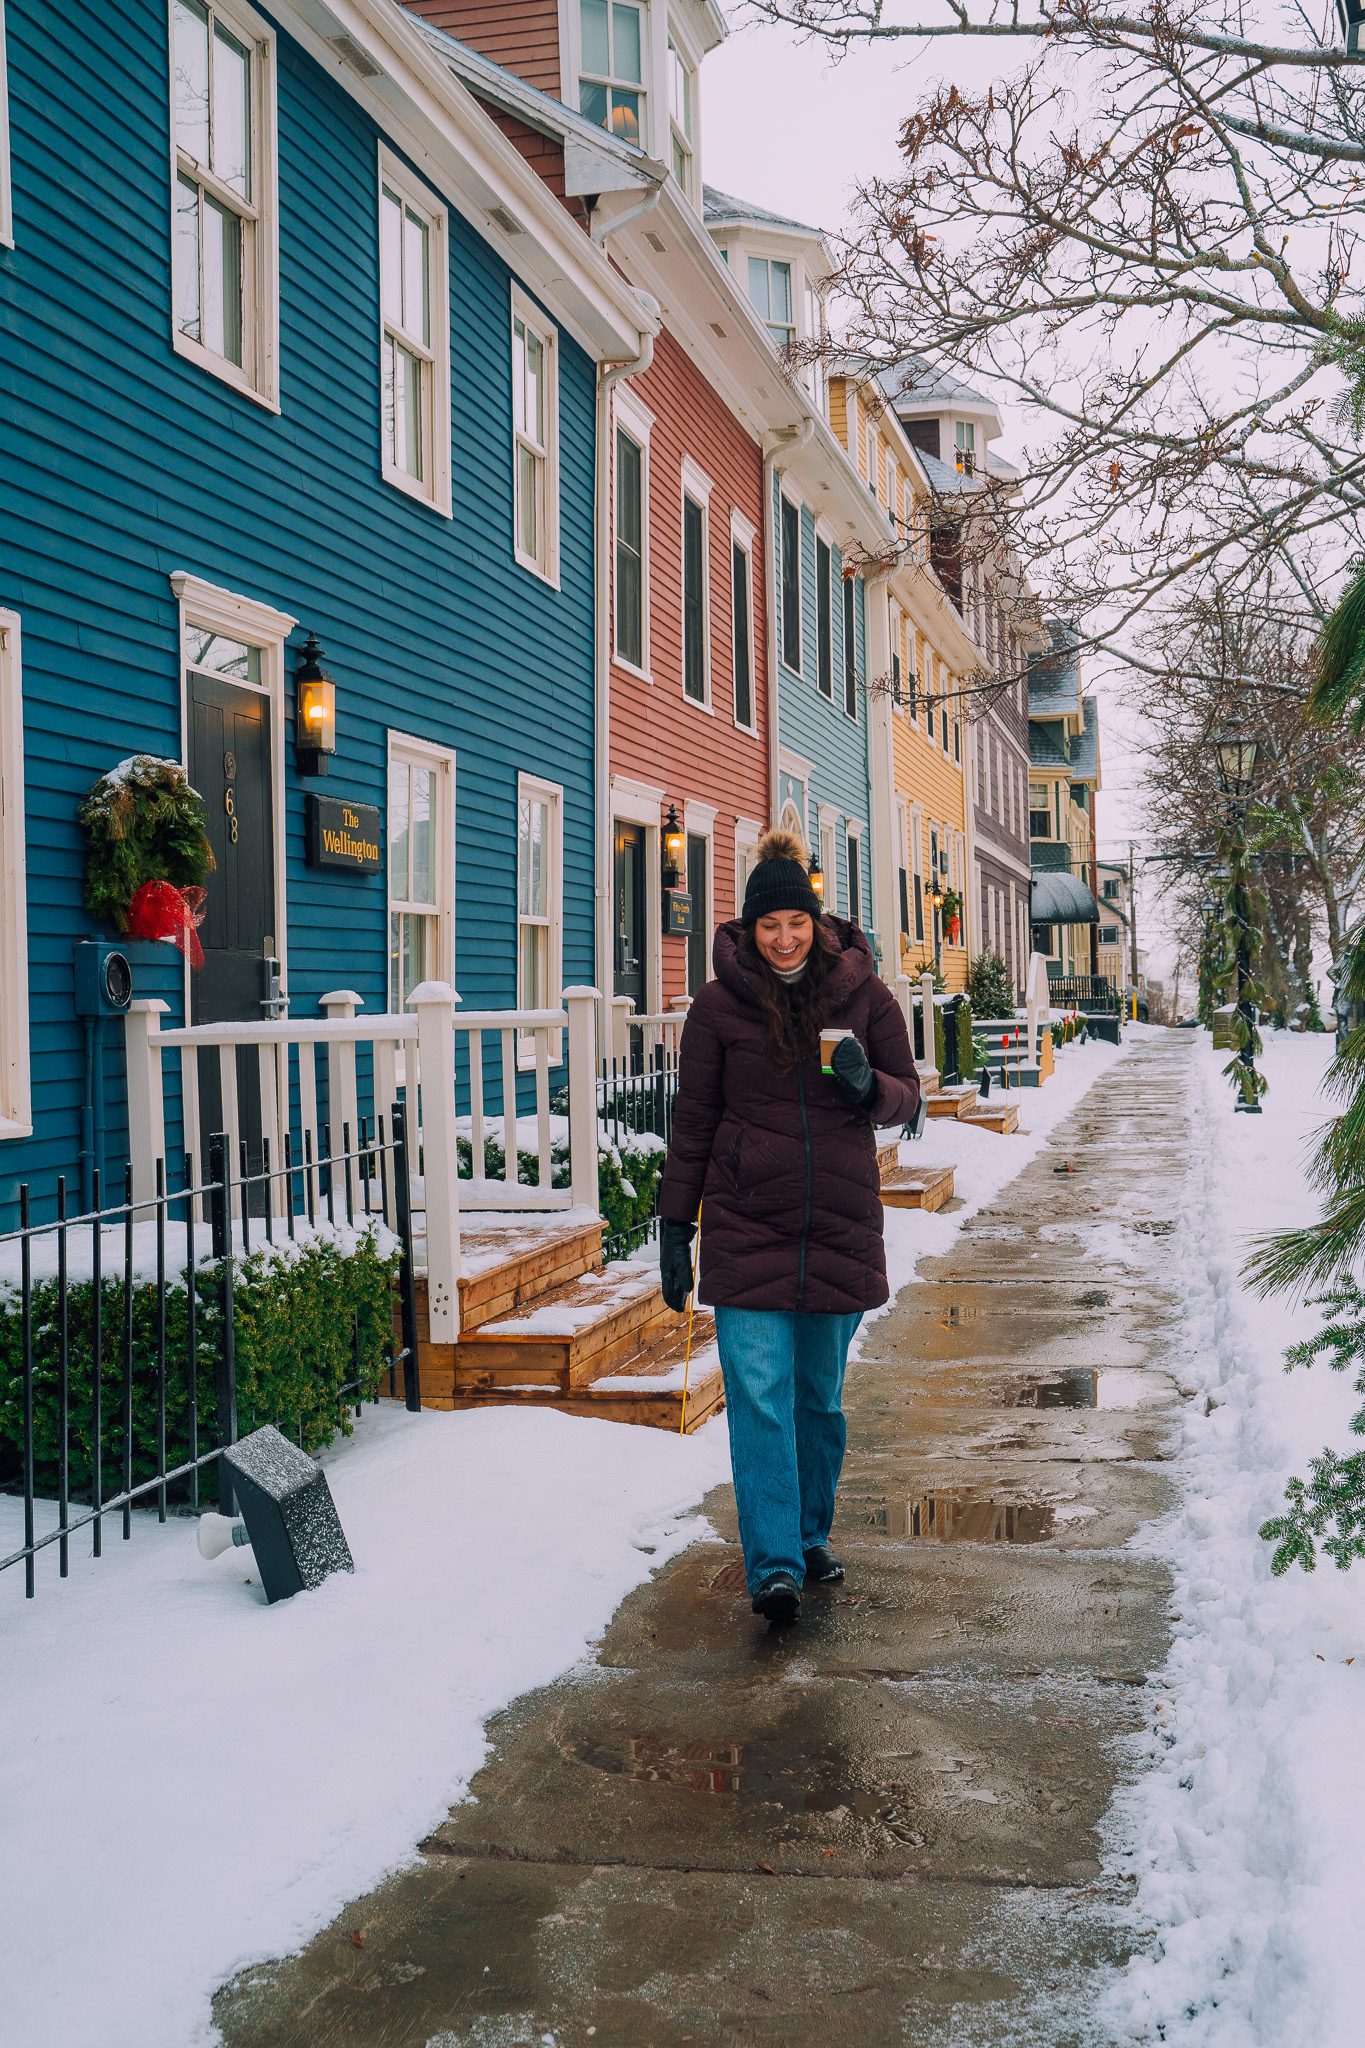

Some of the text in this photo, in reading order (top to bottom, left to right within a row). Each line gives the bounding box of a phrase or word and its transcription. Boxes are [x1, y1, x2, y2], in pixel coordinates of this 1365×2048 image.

[225, 787, 239, 844] 68
[342, 808, 360, 828] The
[322, 829, 379, 863] Wellington
